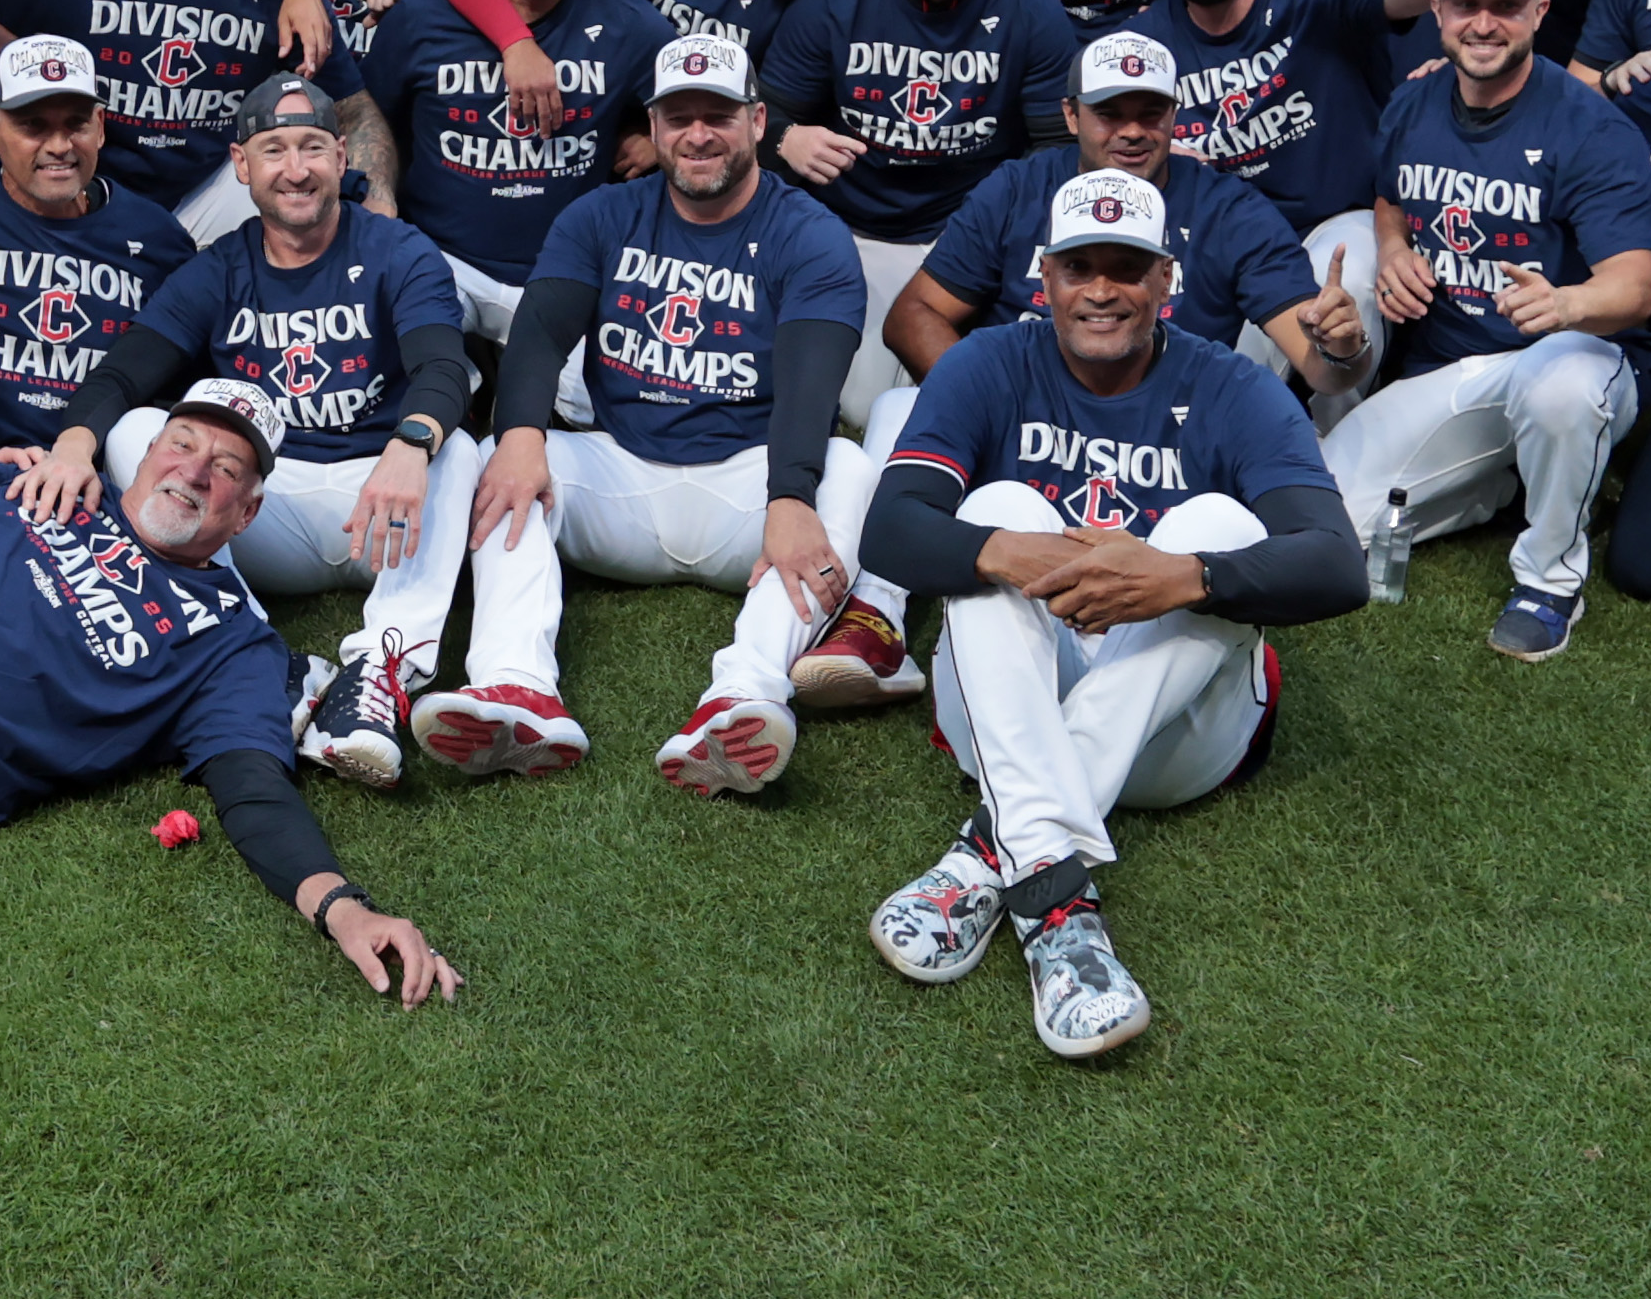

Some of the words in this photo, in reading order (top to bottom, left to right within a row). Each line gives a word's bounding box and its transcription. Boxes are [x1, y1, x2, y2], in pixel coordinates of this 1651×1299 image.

[89, 0, 265, 54] DIVISION
[9, 45, 90, 76] CHAMPIONS
[161, 39, 197, 86] C
[437, 60, 606, 97] DIVON
[661, 46, 736, 72] CHAMPIONS
[846, 42, 1000, 84] DIVISION
[1094, 46, 1168, 73] CHAMPIONS
[907, 79, 939, 125] C
[441, 131, 599, 171] CHAMPS
[841, 106, 997, 152] CHAMPS
[1063, 186, 1152, 218] CHAMPIONS
[1398, 165, 1541, 222] DIVISION
[1442, 206, 1471, 252] C
[40, 287, 77, 343] C
[661, 292, 701, 346] C
[598, 323, 759, 389] CHAMPS
[700, 384, 756, 399] CENTRAL
[1083, 474, 1124, 529] C
[77, 609, 113, 670] CENTRAL
[143, 601, 173, 634] 25
